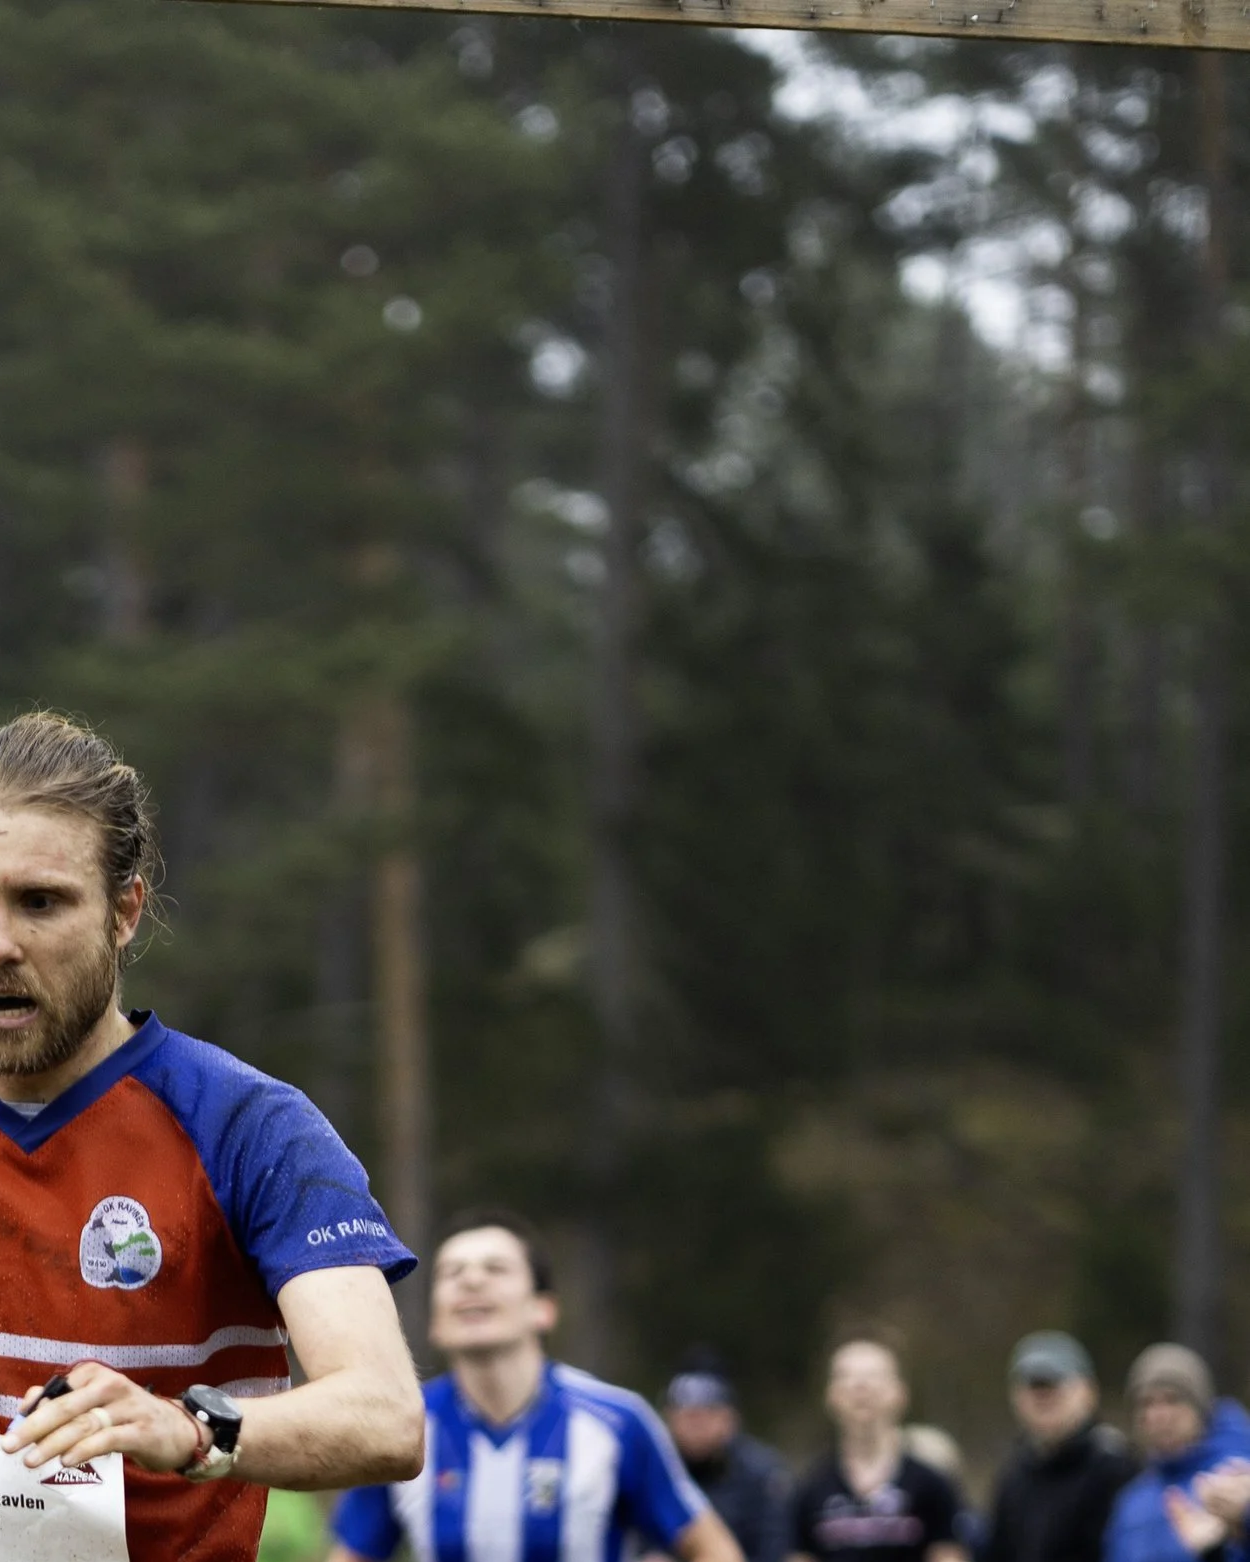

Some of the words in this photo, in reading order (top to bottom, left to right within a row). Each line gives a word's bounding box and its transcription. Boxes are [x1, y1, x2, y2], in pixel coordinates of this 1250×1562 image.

[102, 1201, 114, 1214] OK
[117, 1201, 145, 1228] RAVINEN
[307, 1225, 336, 1246] OK
